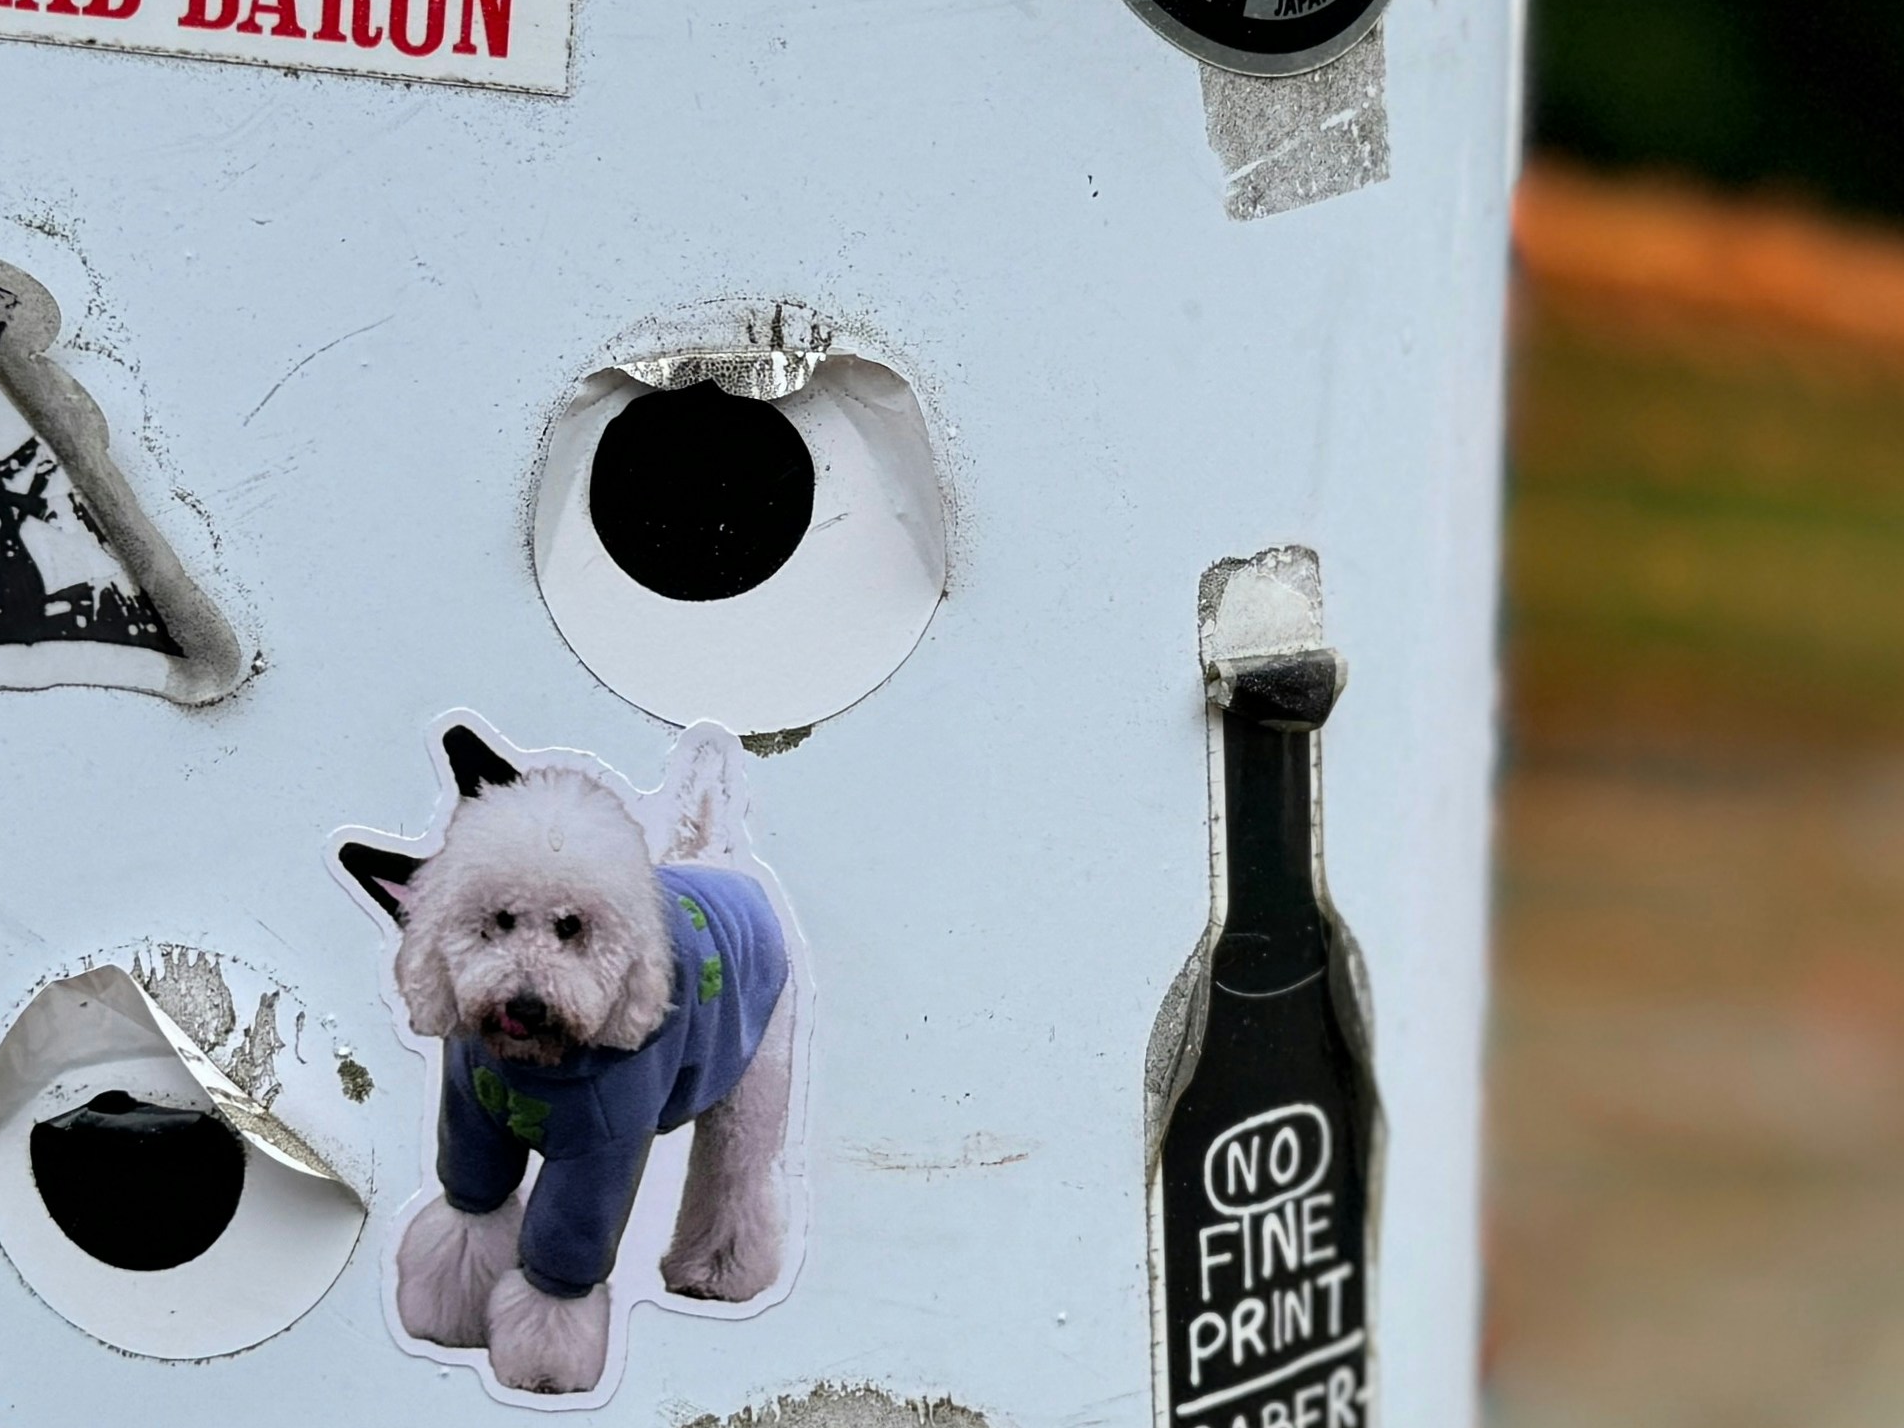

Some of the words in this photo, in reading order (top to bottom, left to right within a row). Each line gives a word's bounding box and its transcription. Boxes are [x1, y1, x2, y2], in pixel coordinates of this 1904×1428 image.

[1227, 1126, 1301, 1197] NO
[1199, 1192, 1337, 1303] FINE
[1189, 1262, 1355, 1387] PRINT
